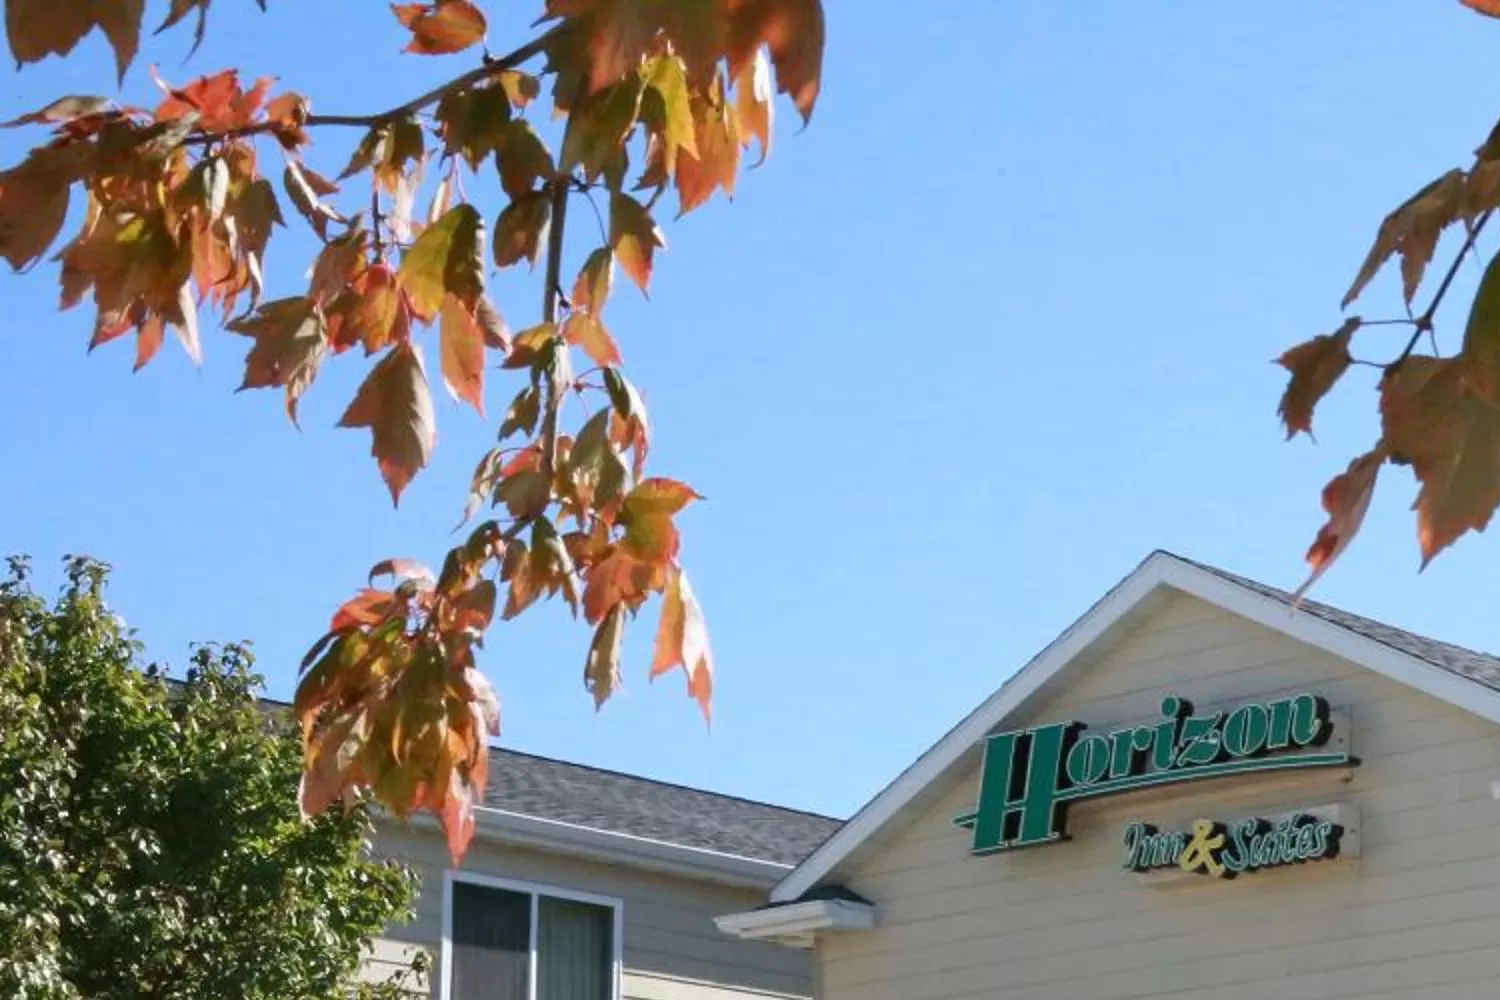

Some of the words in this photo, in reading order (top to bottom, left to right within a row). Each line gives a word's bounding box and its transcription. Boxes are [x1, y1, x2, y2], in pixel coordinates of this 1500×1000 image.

[970, 693, 1323, 854] Horizon
[1122, 820, 1185, 870] Inn
[1180, 818, 1226, 878] &
[1221, 815, 1331, 872] Suites
